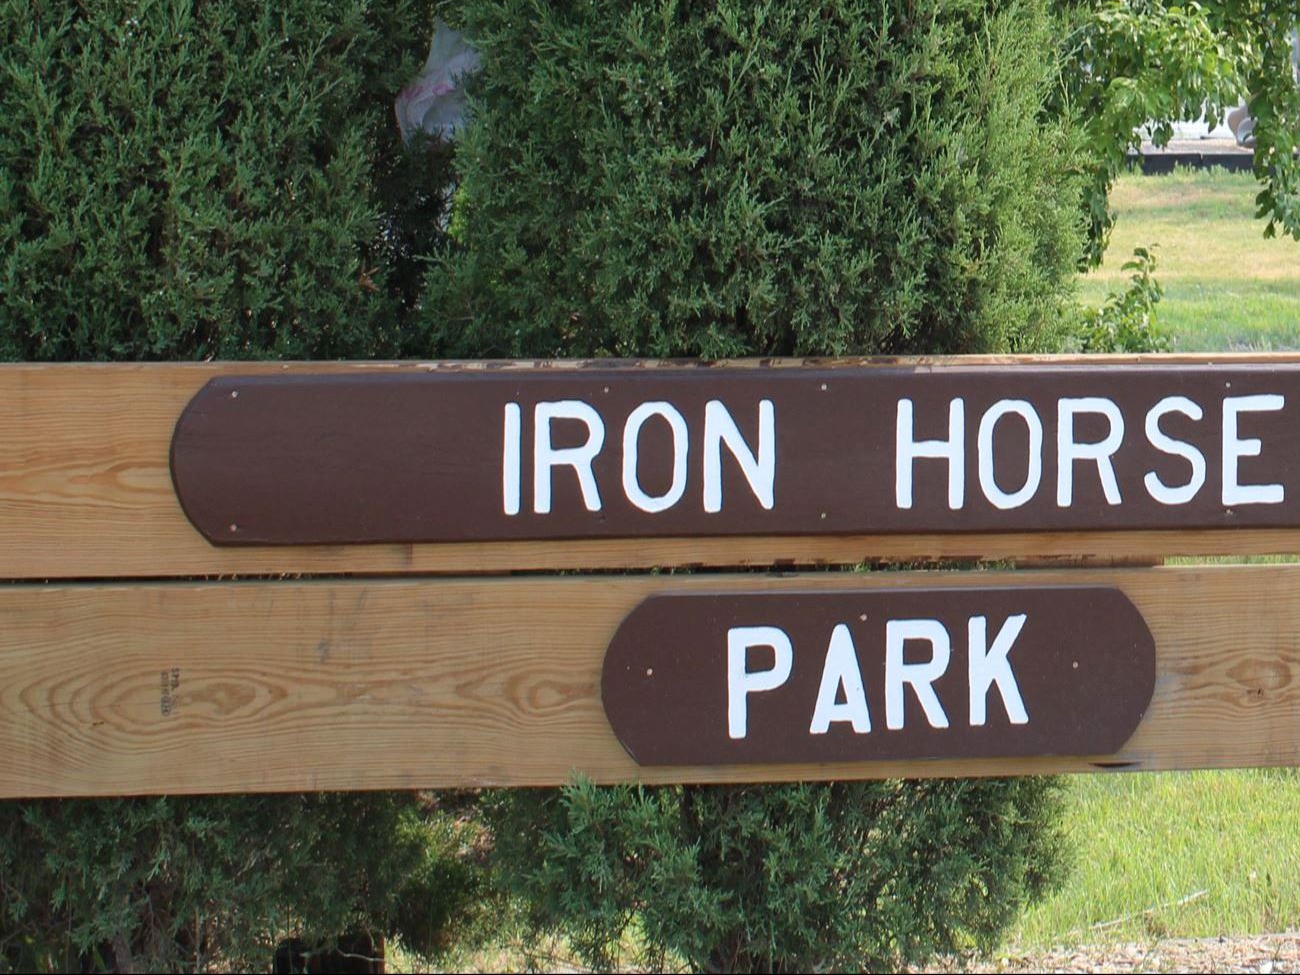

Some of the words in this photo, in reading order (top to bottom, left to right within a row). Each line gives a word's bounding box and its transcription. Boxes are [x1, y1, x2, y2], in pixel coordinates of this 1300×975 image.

[501, 399, 777, 516] IRON
[894, 395, 1286, 511] HORSE
[726, 613, 1030, 740] PARK
